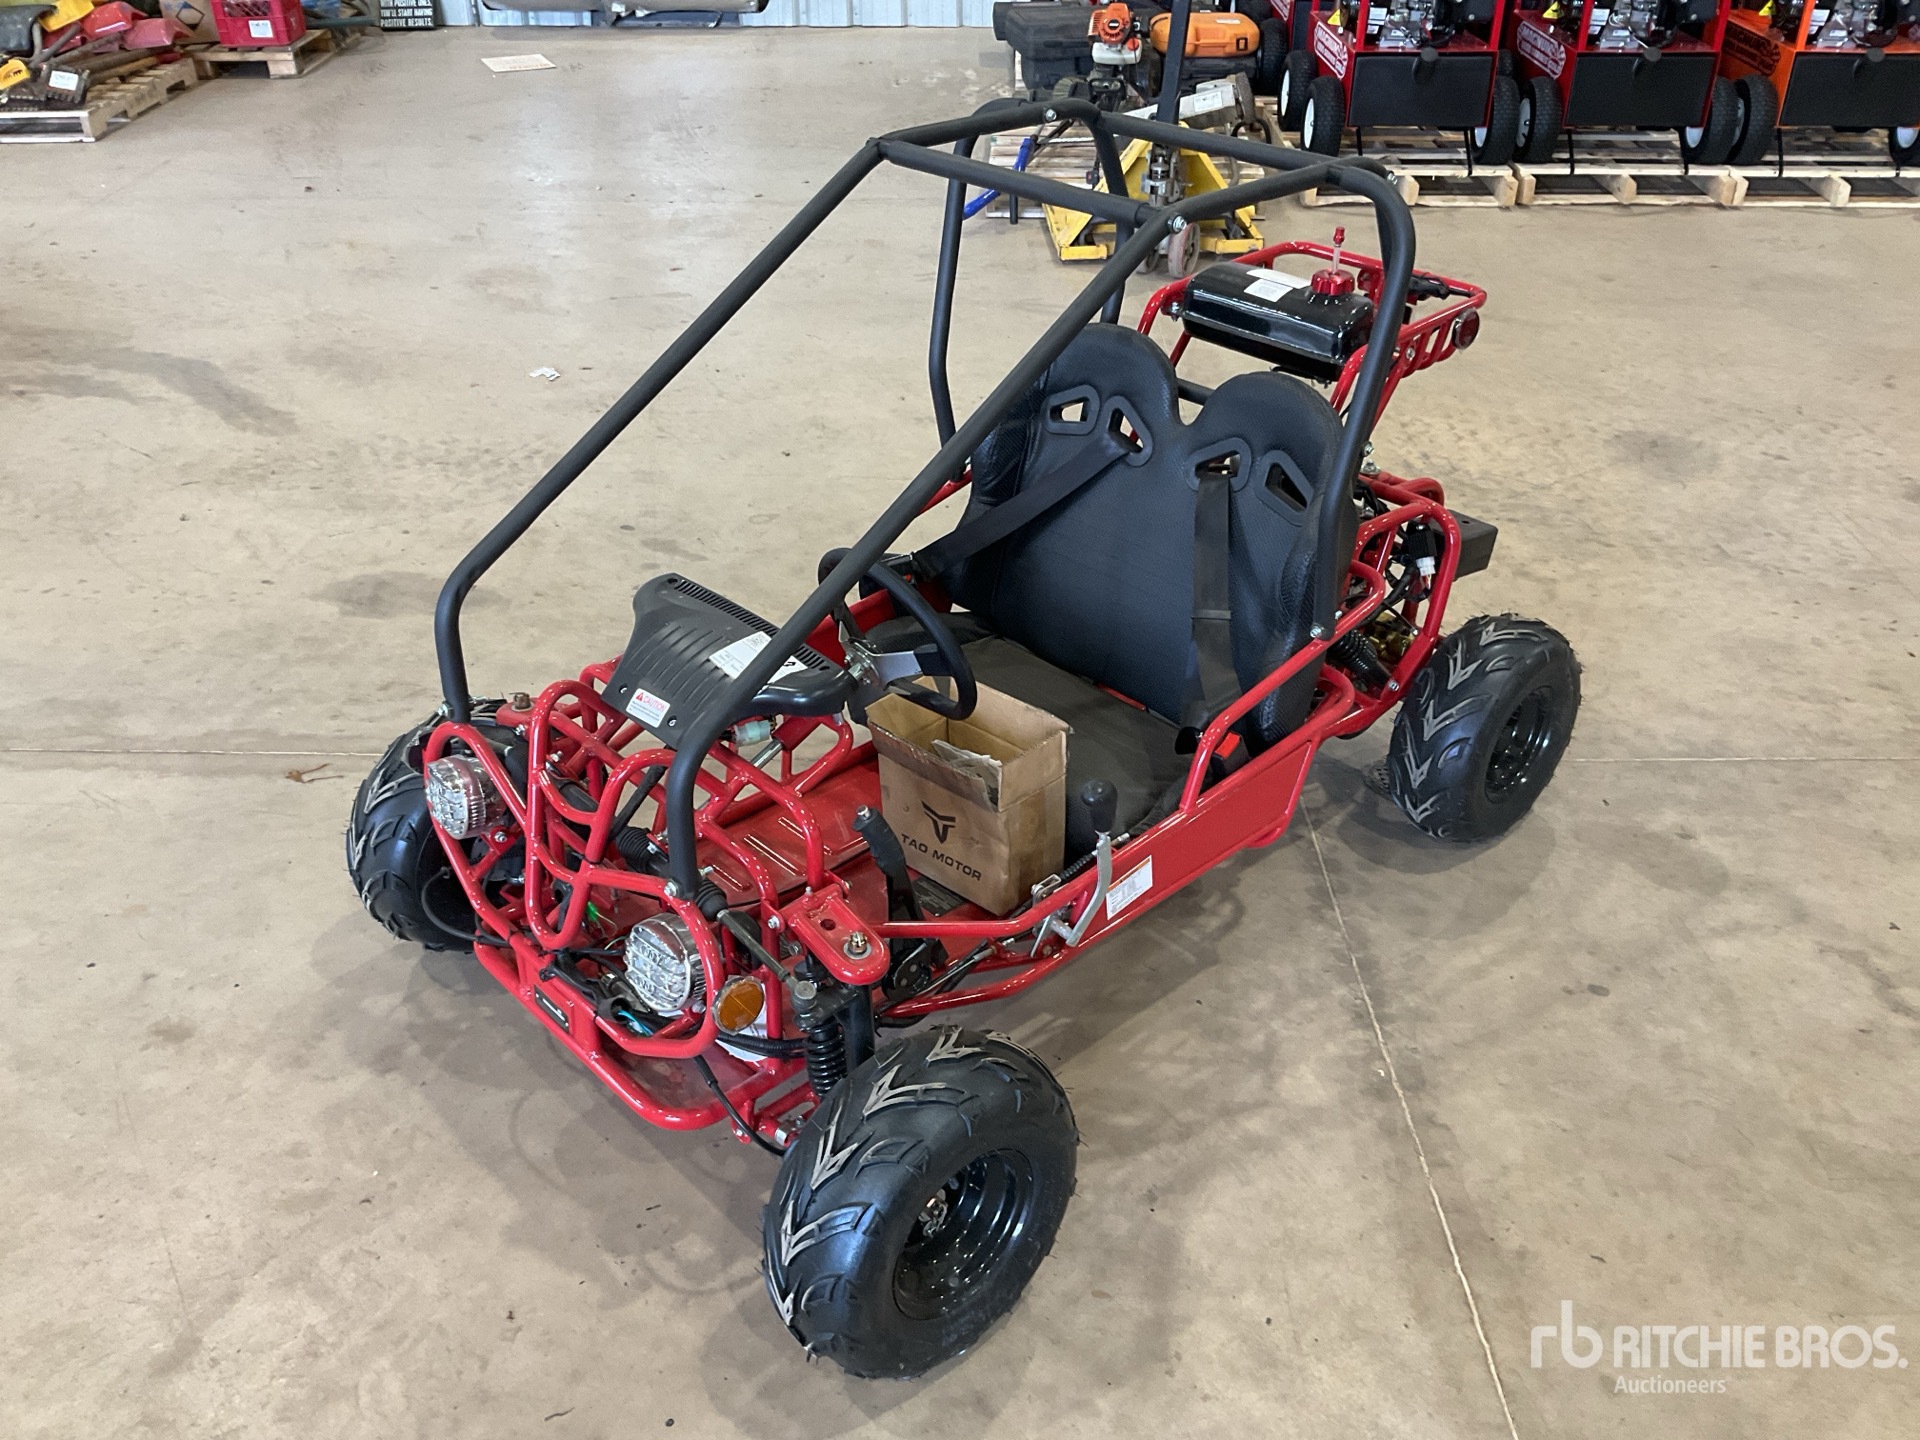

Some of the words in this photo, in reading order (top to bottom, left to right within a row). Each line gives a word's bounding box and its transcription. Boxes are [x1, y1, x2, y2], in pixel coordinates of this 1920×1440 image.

[398, 8, 413, 17] START
[414, 8, 433, 16] HAVING
[381, 18, 407, 27] POSITIVE
[644, 695, 667, 712] CAUTION
[901, 833, 928, 854] TAO
[932, 849, 982, 882] MOTOR
